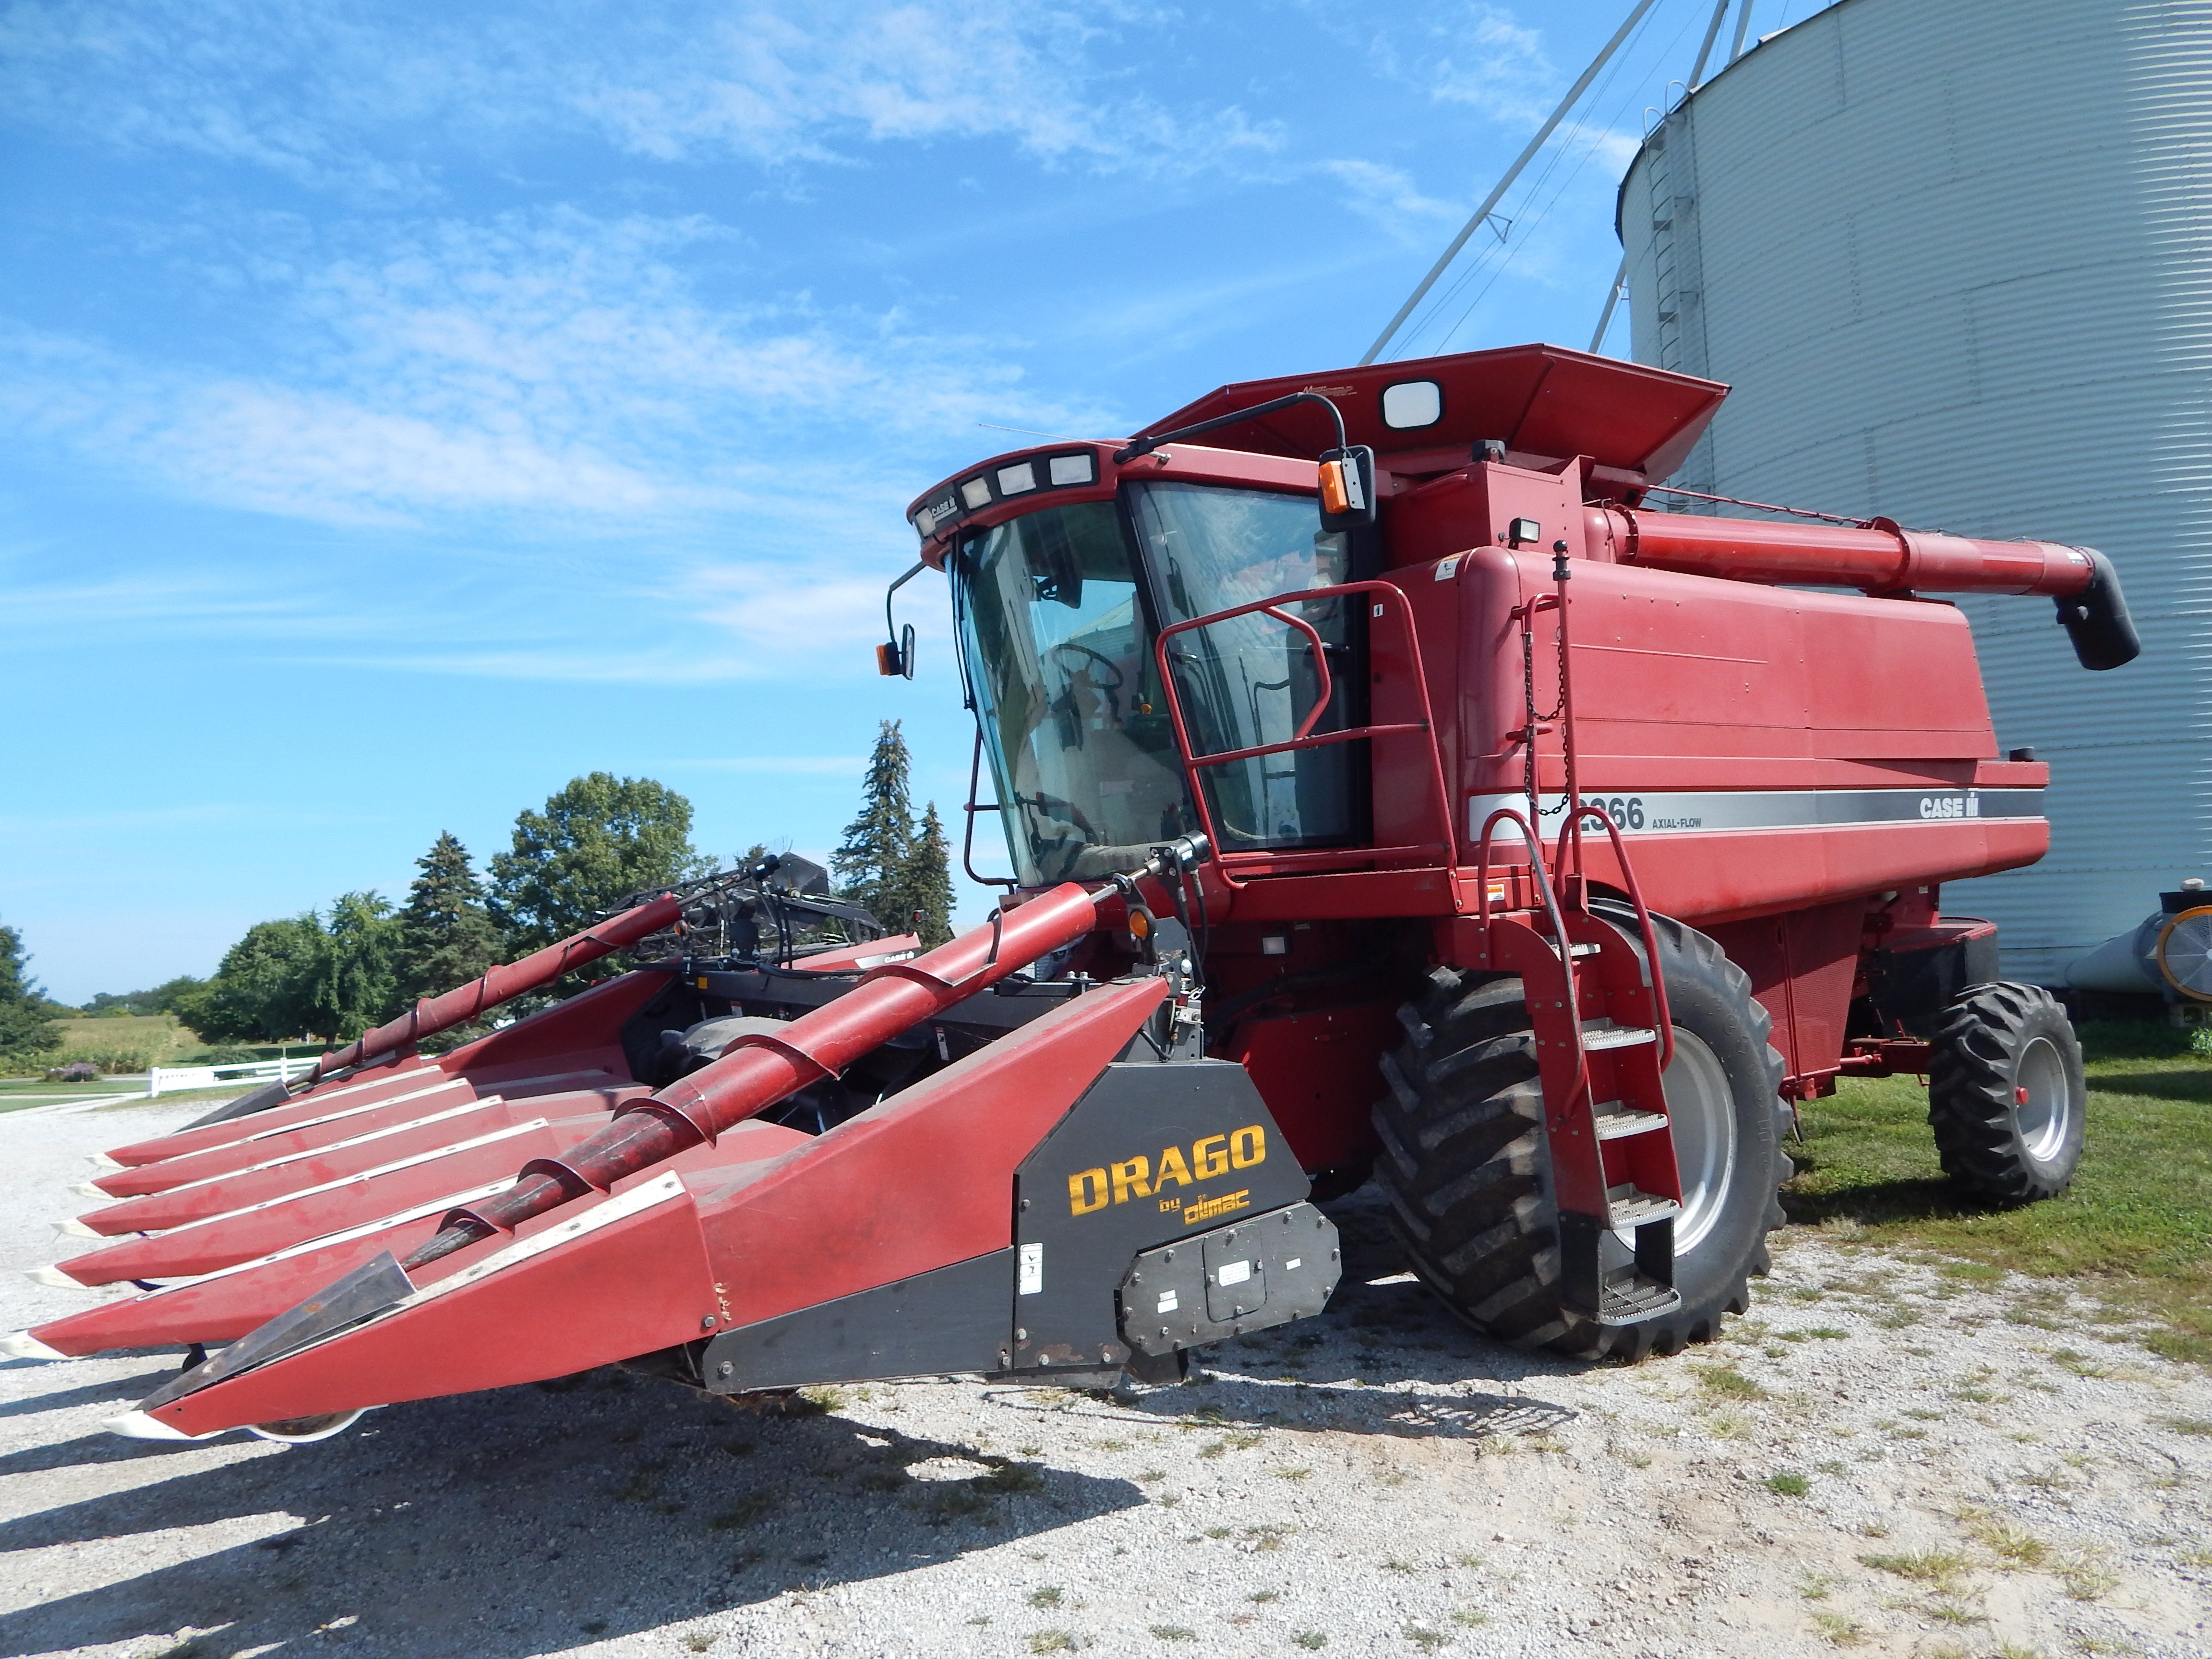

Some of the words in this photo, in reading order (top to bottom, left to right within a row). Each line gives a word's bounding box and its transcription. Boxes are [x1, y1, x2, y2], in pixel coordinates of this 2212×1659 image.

[931, 501, 949, 517] CASE
[1920, 797, 1963, 818] CASE
[1068, 1124, 1266, 1217] DRAGO
[1158, 1197, 1181, 1213] by
